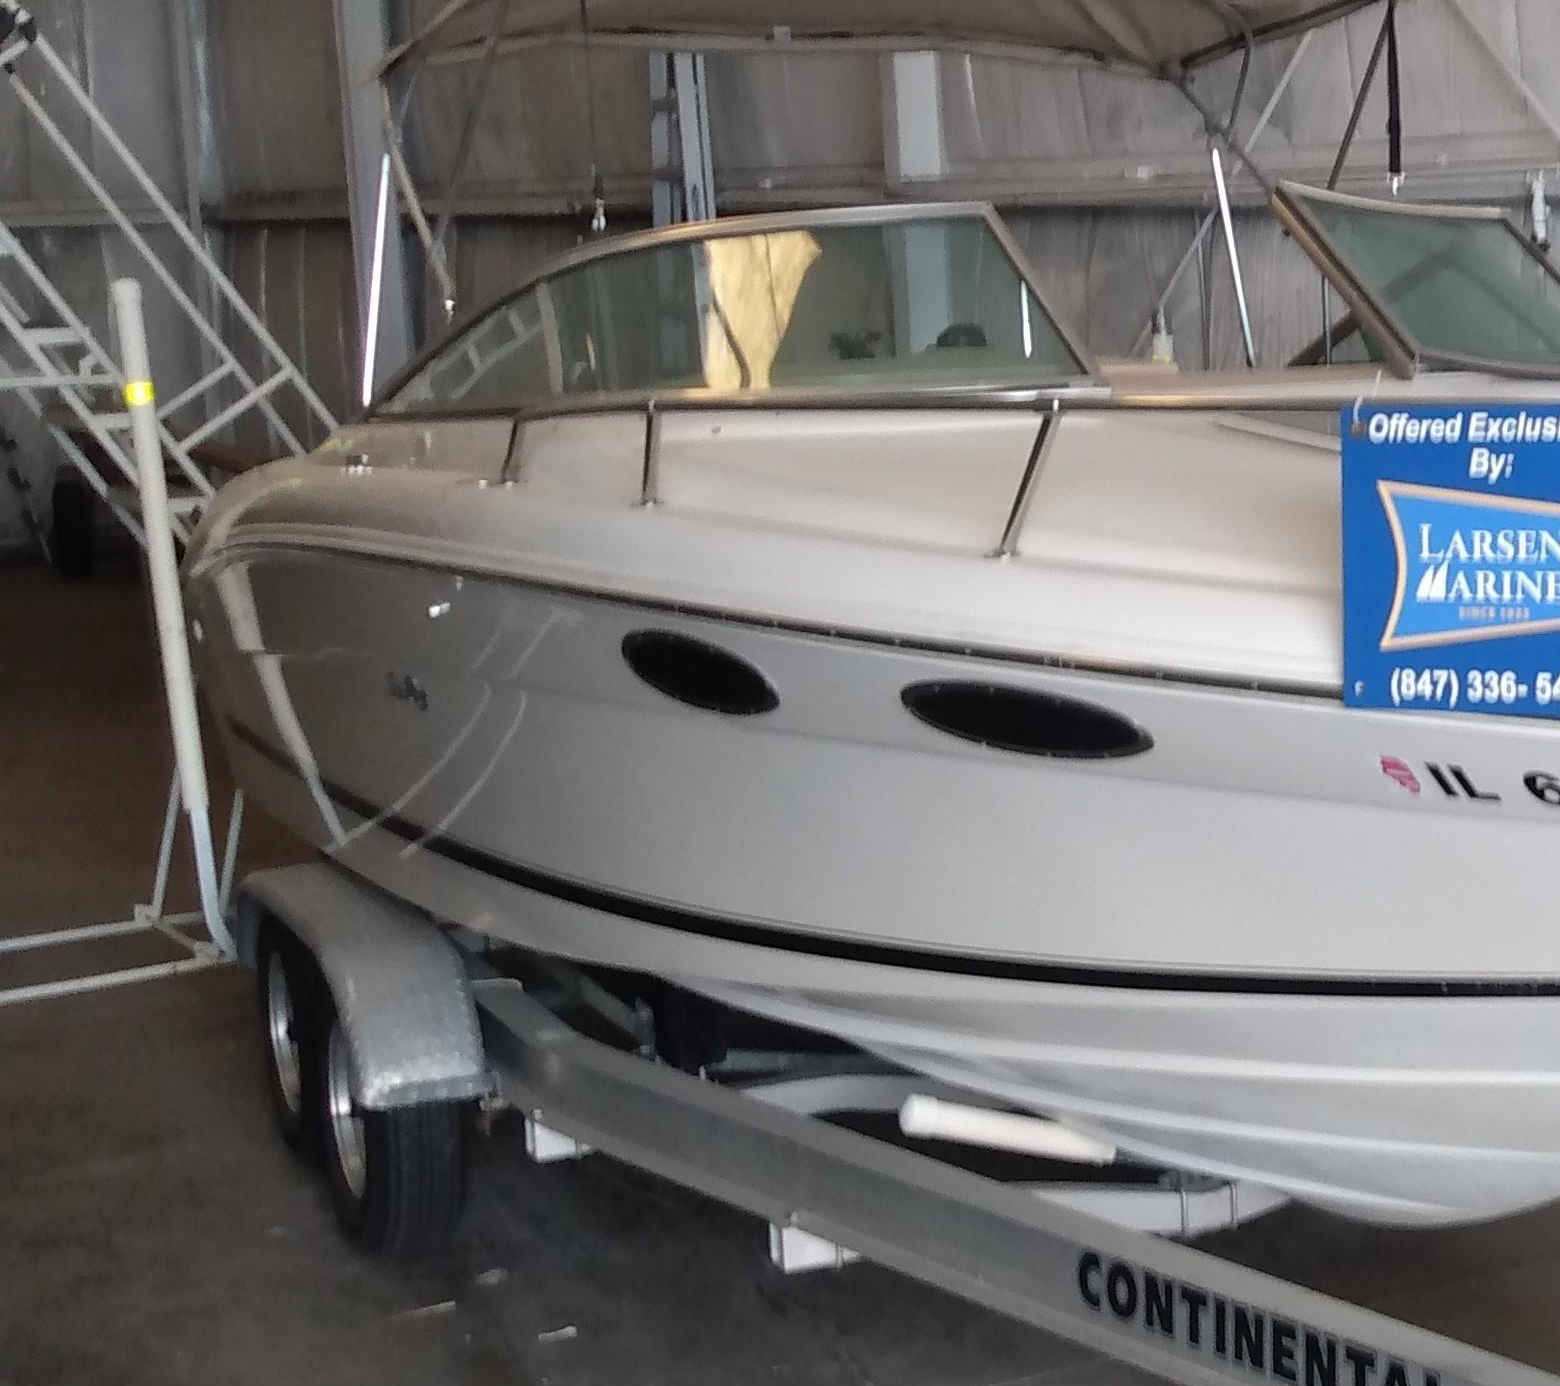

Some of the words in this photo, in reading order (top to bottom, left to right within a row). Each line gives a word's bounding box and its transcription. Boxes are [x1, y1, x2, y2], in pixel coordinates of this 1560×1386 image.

[1368, 412, 1462, 444] Offered
[1469, 447, 1514, 484] By:
[1390, 667, 1460, 709] (847)
[1466, 669, 1529, 705] 336-
[1425, 761, 1502, 800] IL
